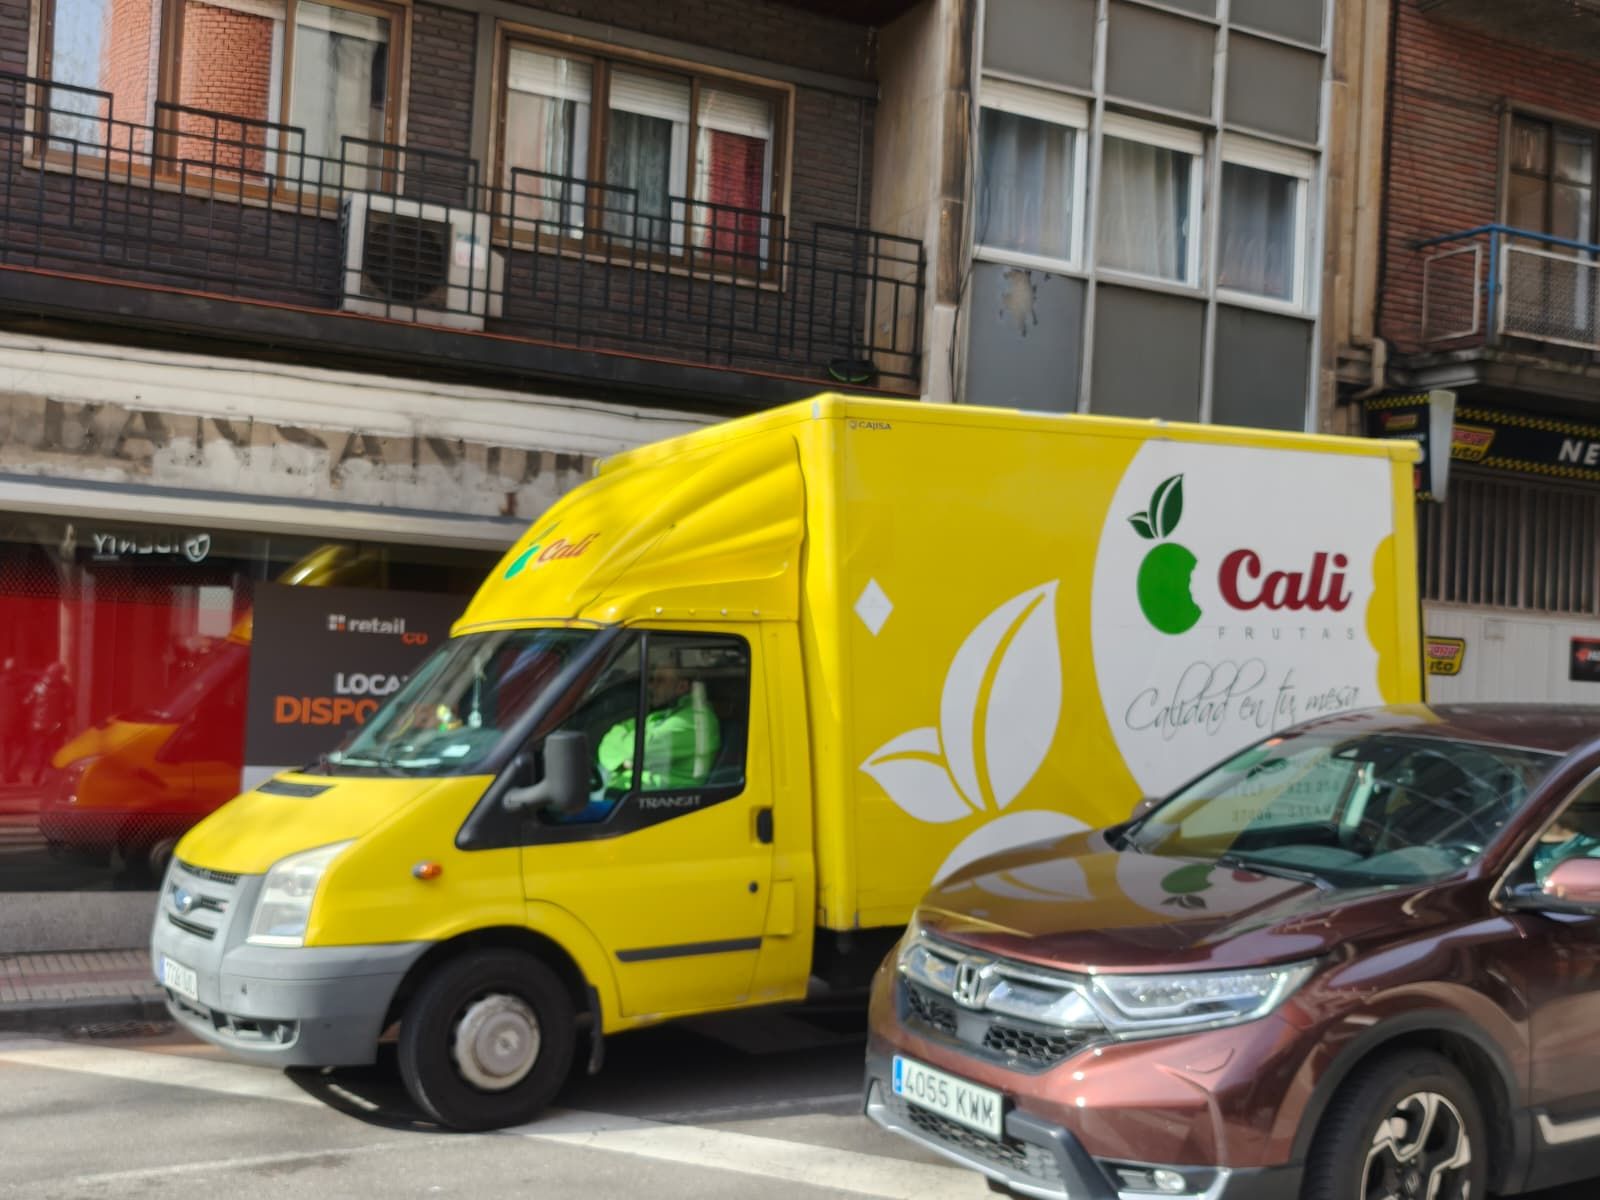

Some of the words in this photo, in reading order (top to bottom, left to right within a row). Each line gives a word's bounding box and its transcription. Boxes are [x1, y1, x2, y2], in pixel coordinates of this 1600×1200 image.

[537, 530, 601, 563] Cali
[1217, 548, 1354, 612] Cali
[349, 617, 406, 634] retail
[1217, 626, 1356, 641] FRUTAS
[335, 672, 409, 695] LOCA
[1124, 657, 1267, 742] Calidad
[1239, 694, 1269, 729] en
[1304, 685, 1360, 712] mesa
[639, 794, 702, 810] TRANSIT
[904, 1065, 949, 1109] 4055
